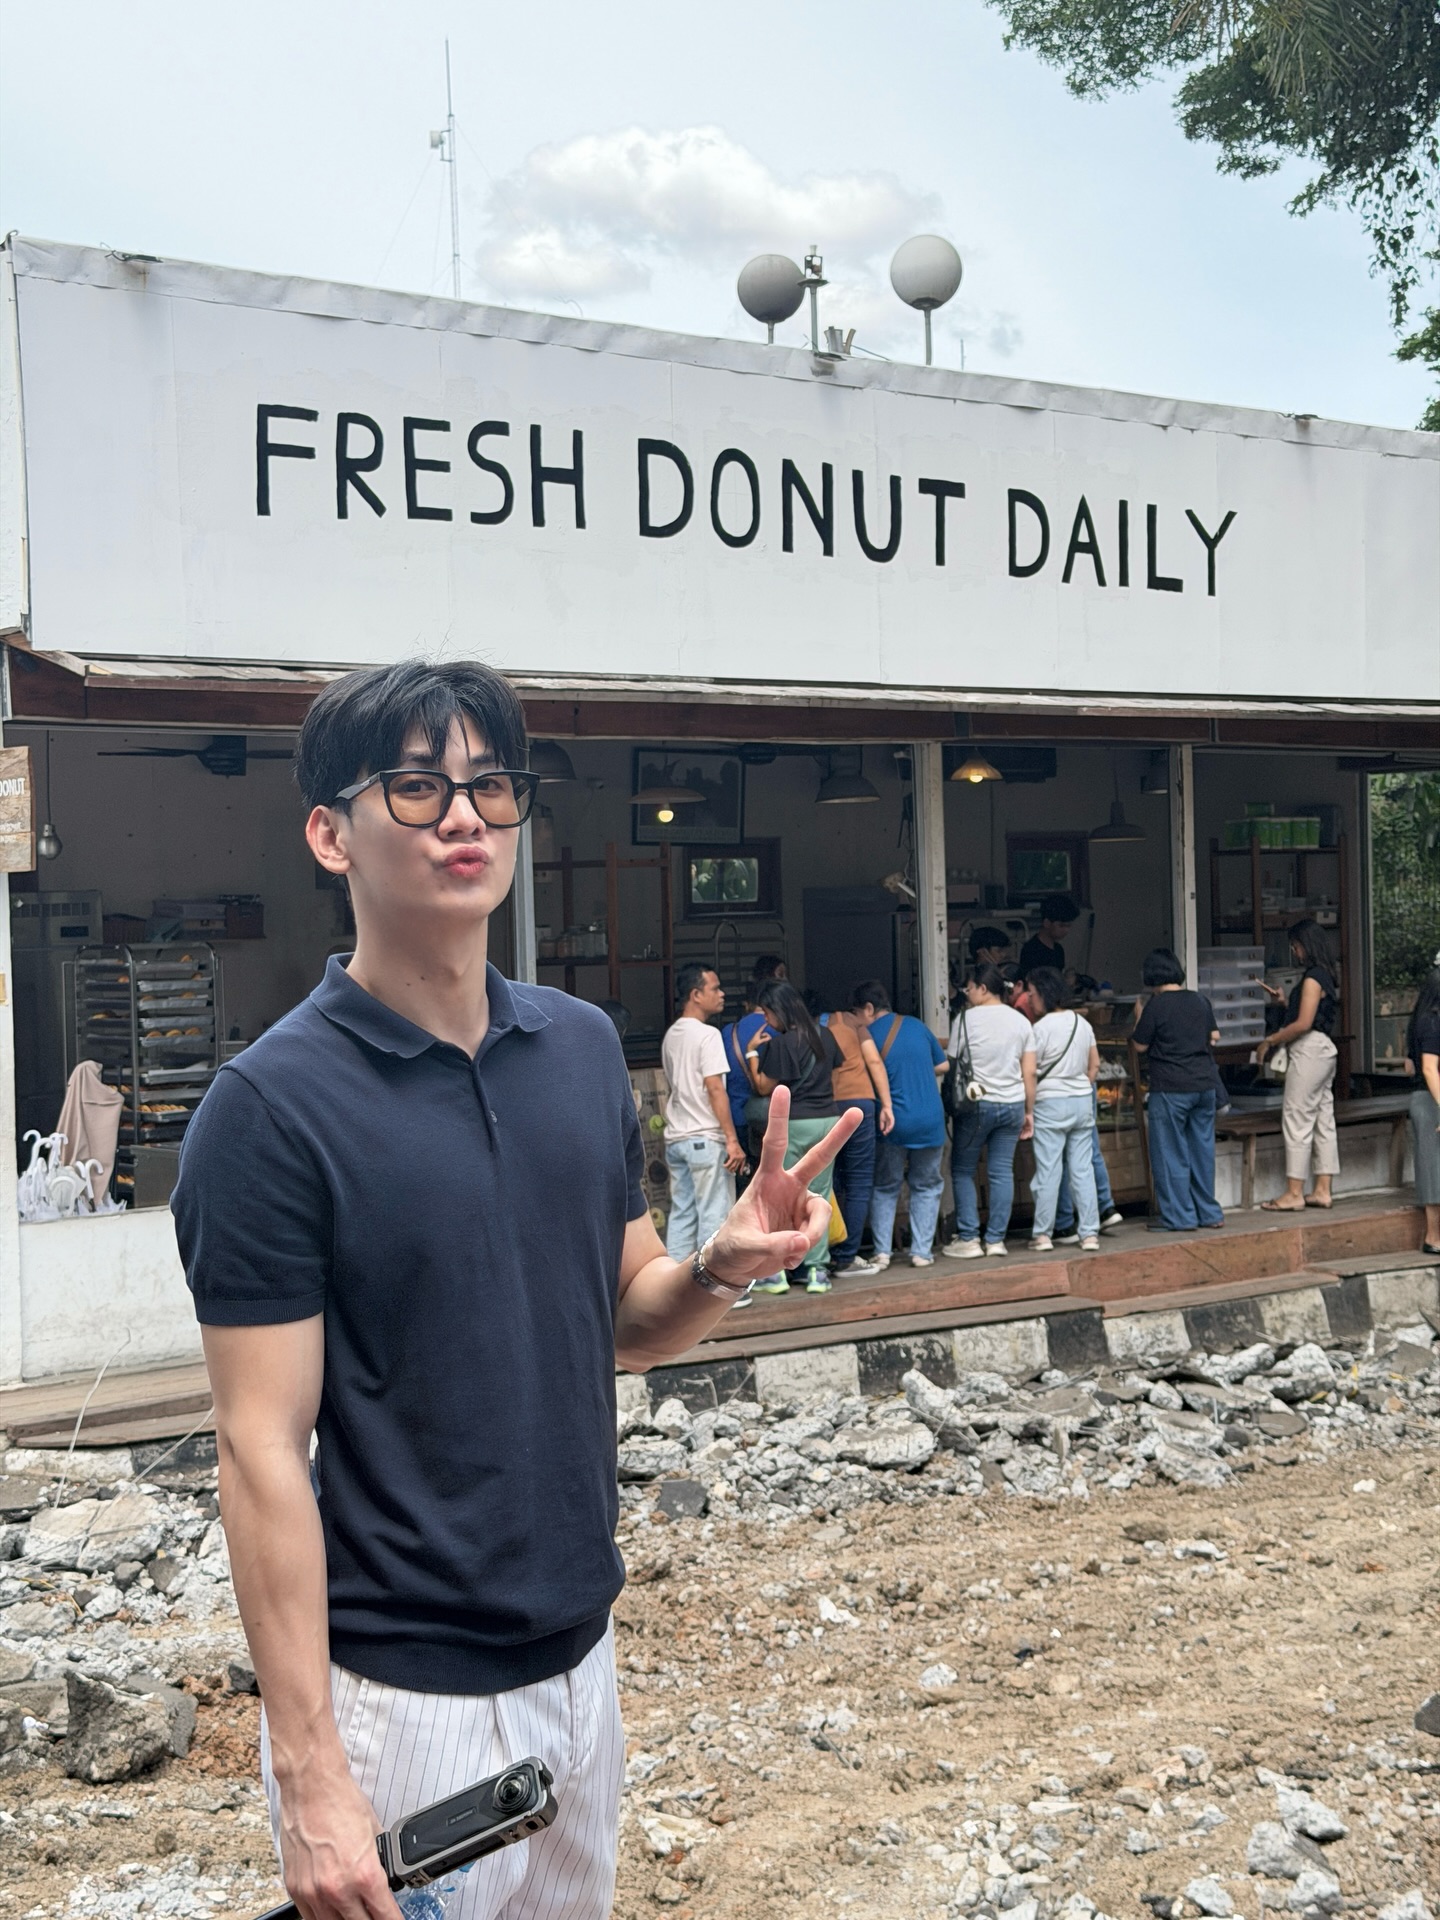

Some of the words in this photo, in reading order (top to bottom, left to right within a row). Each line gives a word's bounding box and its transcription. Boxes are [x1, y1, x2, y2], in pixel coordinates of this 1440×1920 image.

[256, 403, 586, 530] FRESH
[637, 437, 966, 567] DONUT
[1007, 488, 1237, 597] DAILY
